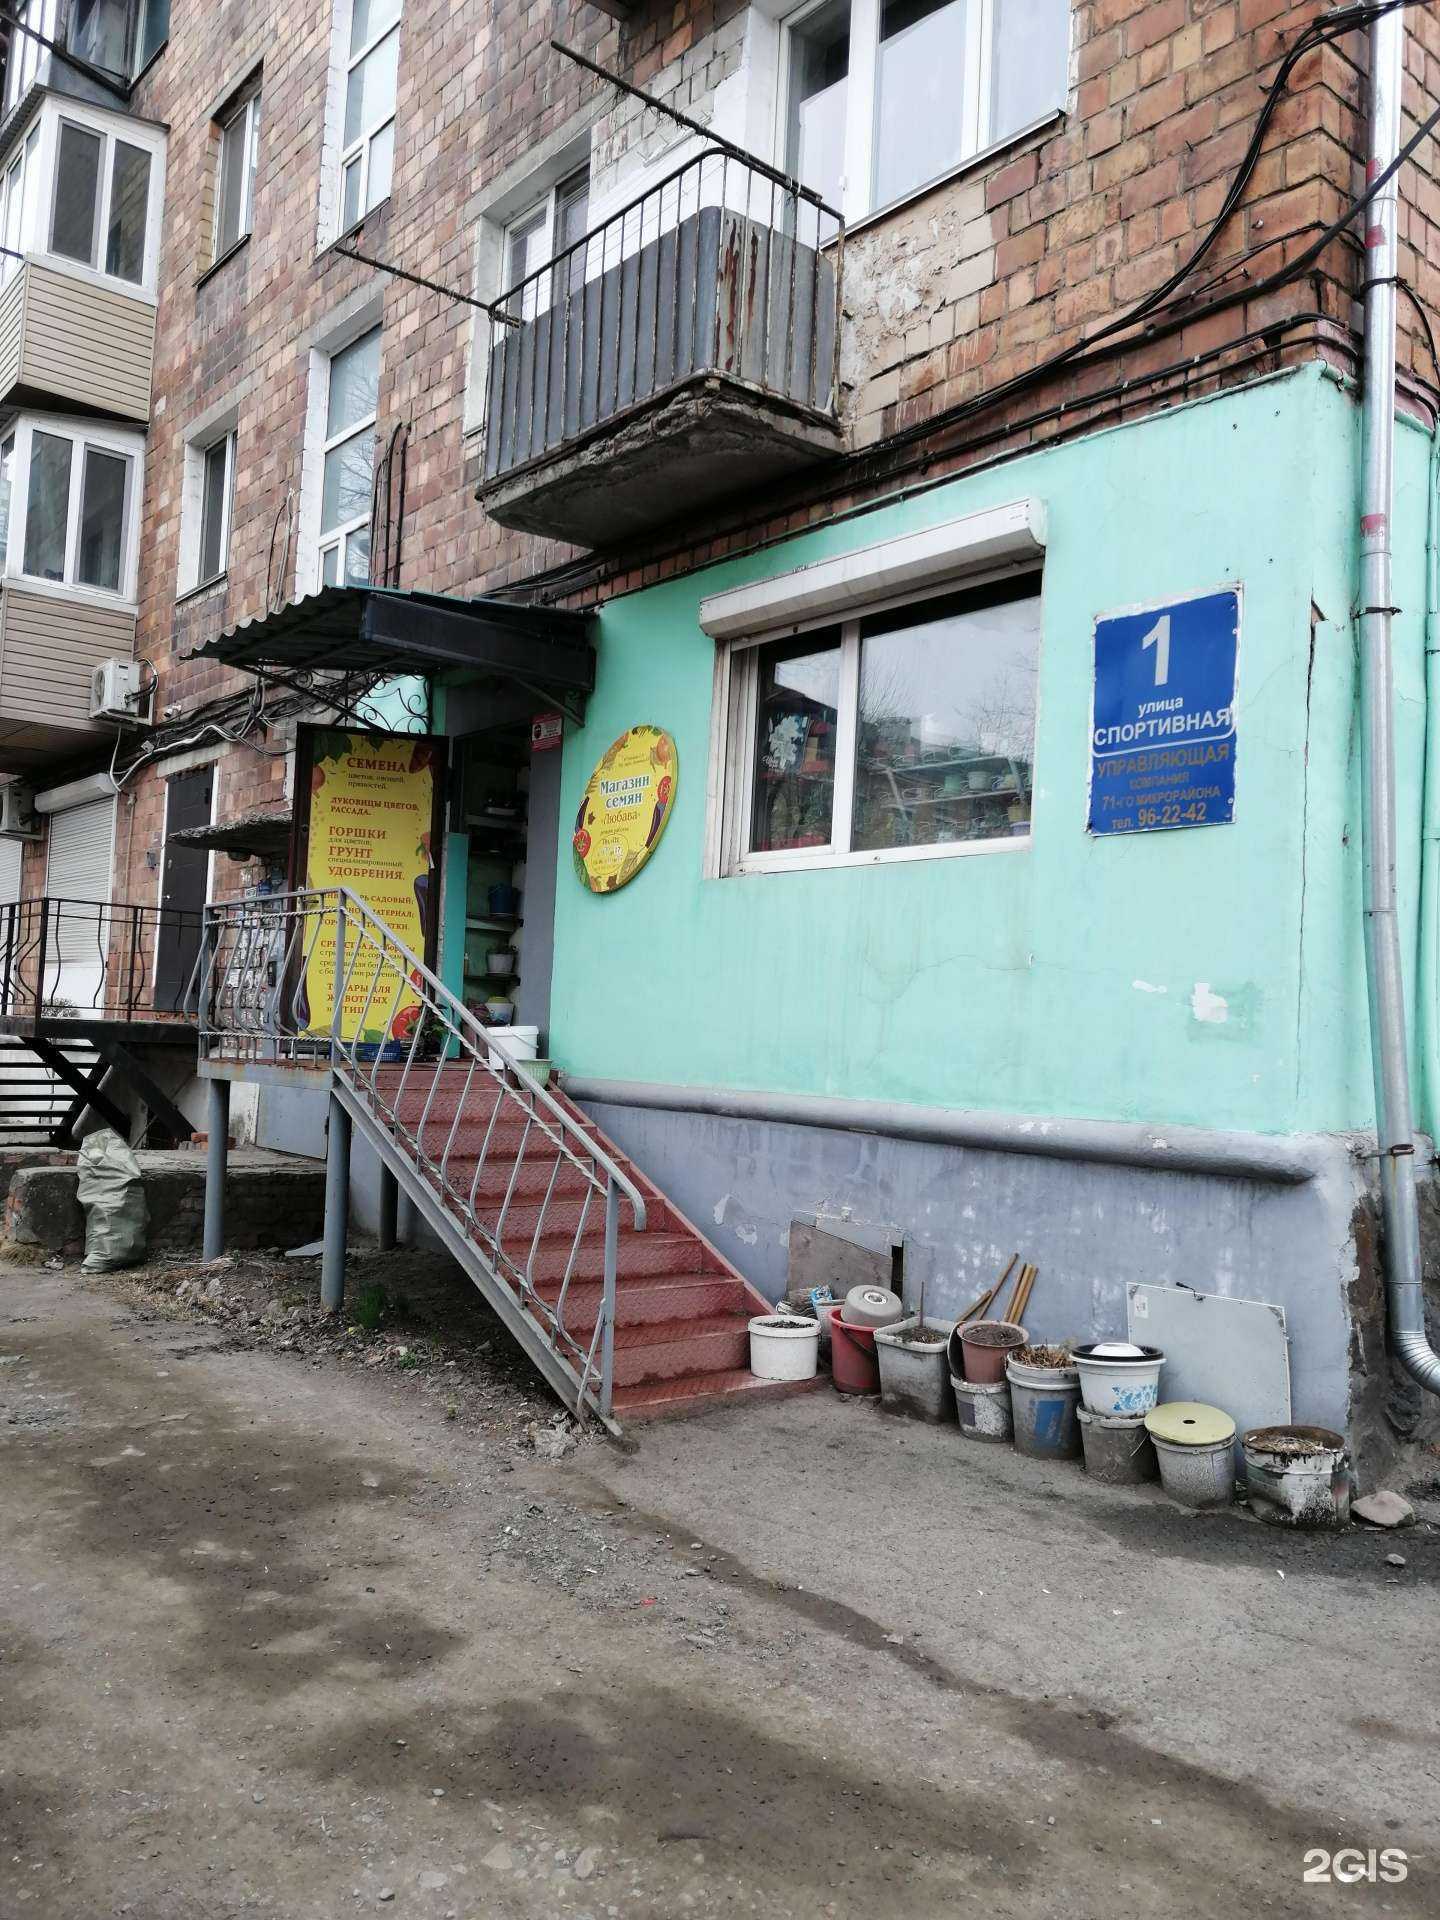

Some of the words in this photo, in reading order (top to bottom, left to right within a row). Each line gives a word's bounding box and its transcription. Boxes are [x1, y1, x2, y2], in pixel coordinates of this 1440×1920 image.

[1142, 614, 1171, 687] 1
[1138, 697, 1184, 718] улица
[1094, 706, 1231, 746] СПОРТИВНАЯ
[346, 757, 407, 773] СЕМЕНА
[1097, 743, 1230, 778] УПРАВЛЯЮЩАЯ
[600, 775, 650, 795] Магазин
[1129, 771, 1190, 790] КОМПАНИЯ
[331, 796, 382, 808] ЛУКОВИЦЫ
[605, 793, 642, 808] семян
[1136, 785, 1221, 804] МИКРОРАЙОНА
[1138, 802, 1207, 827] 96-22-42
[328, 826, 387, 840] ГОРШКИ
[328, 845, 374, 859] ГРУНТ
[328, 865, 406, 880] УДОБРЕНИЯ.
